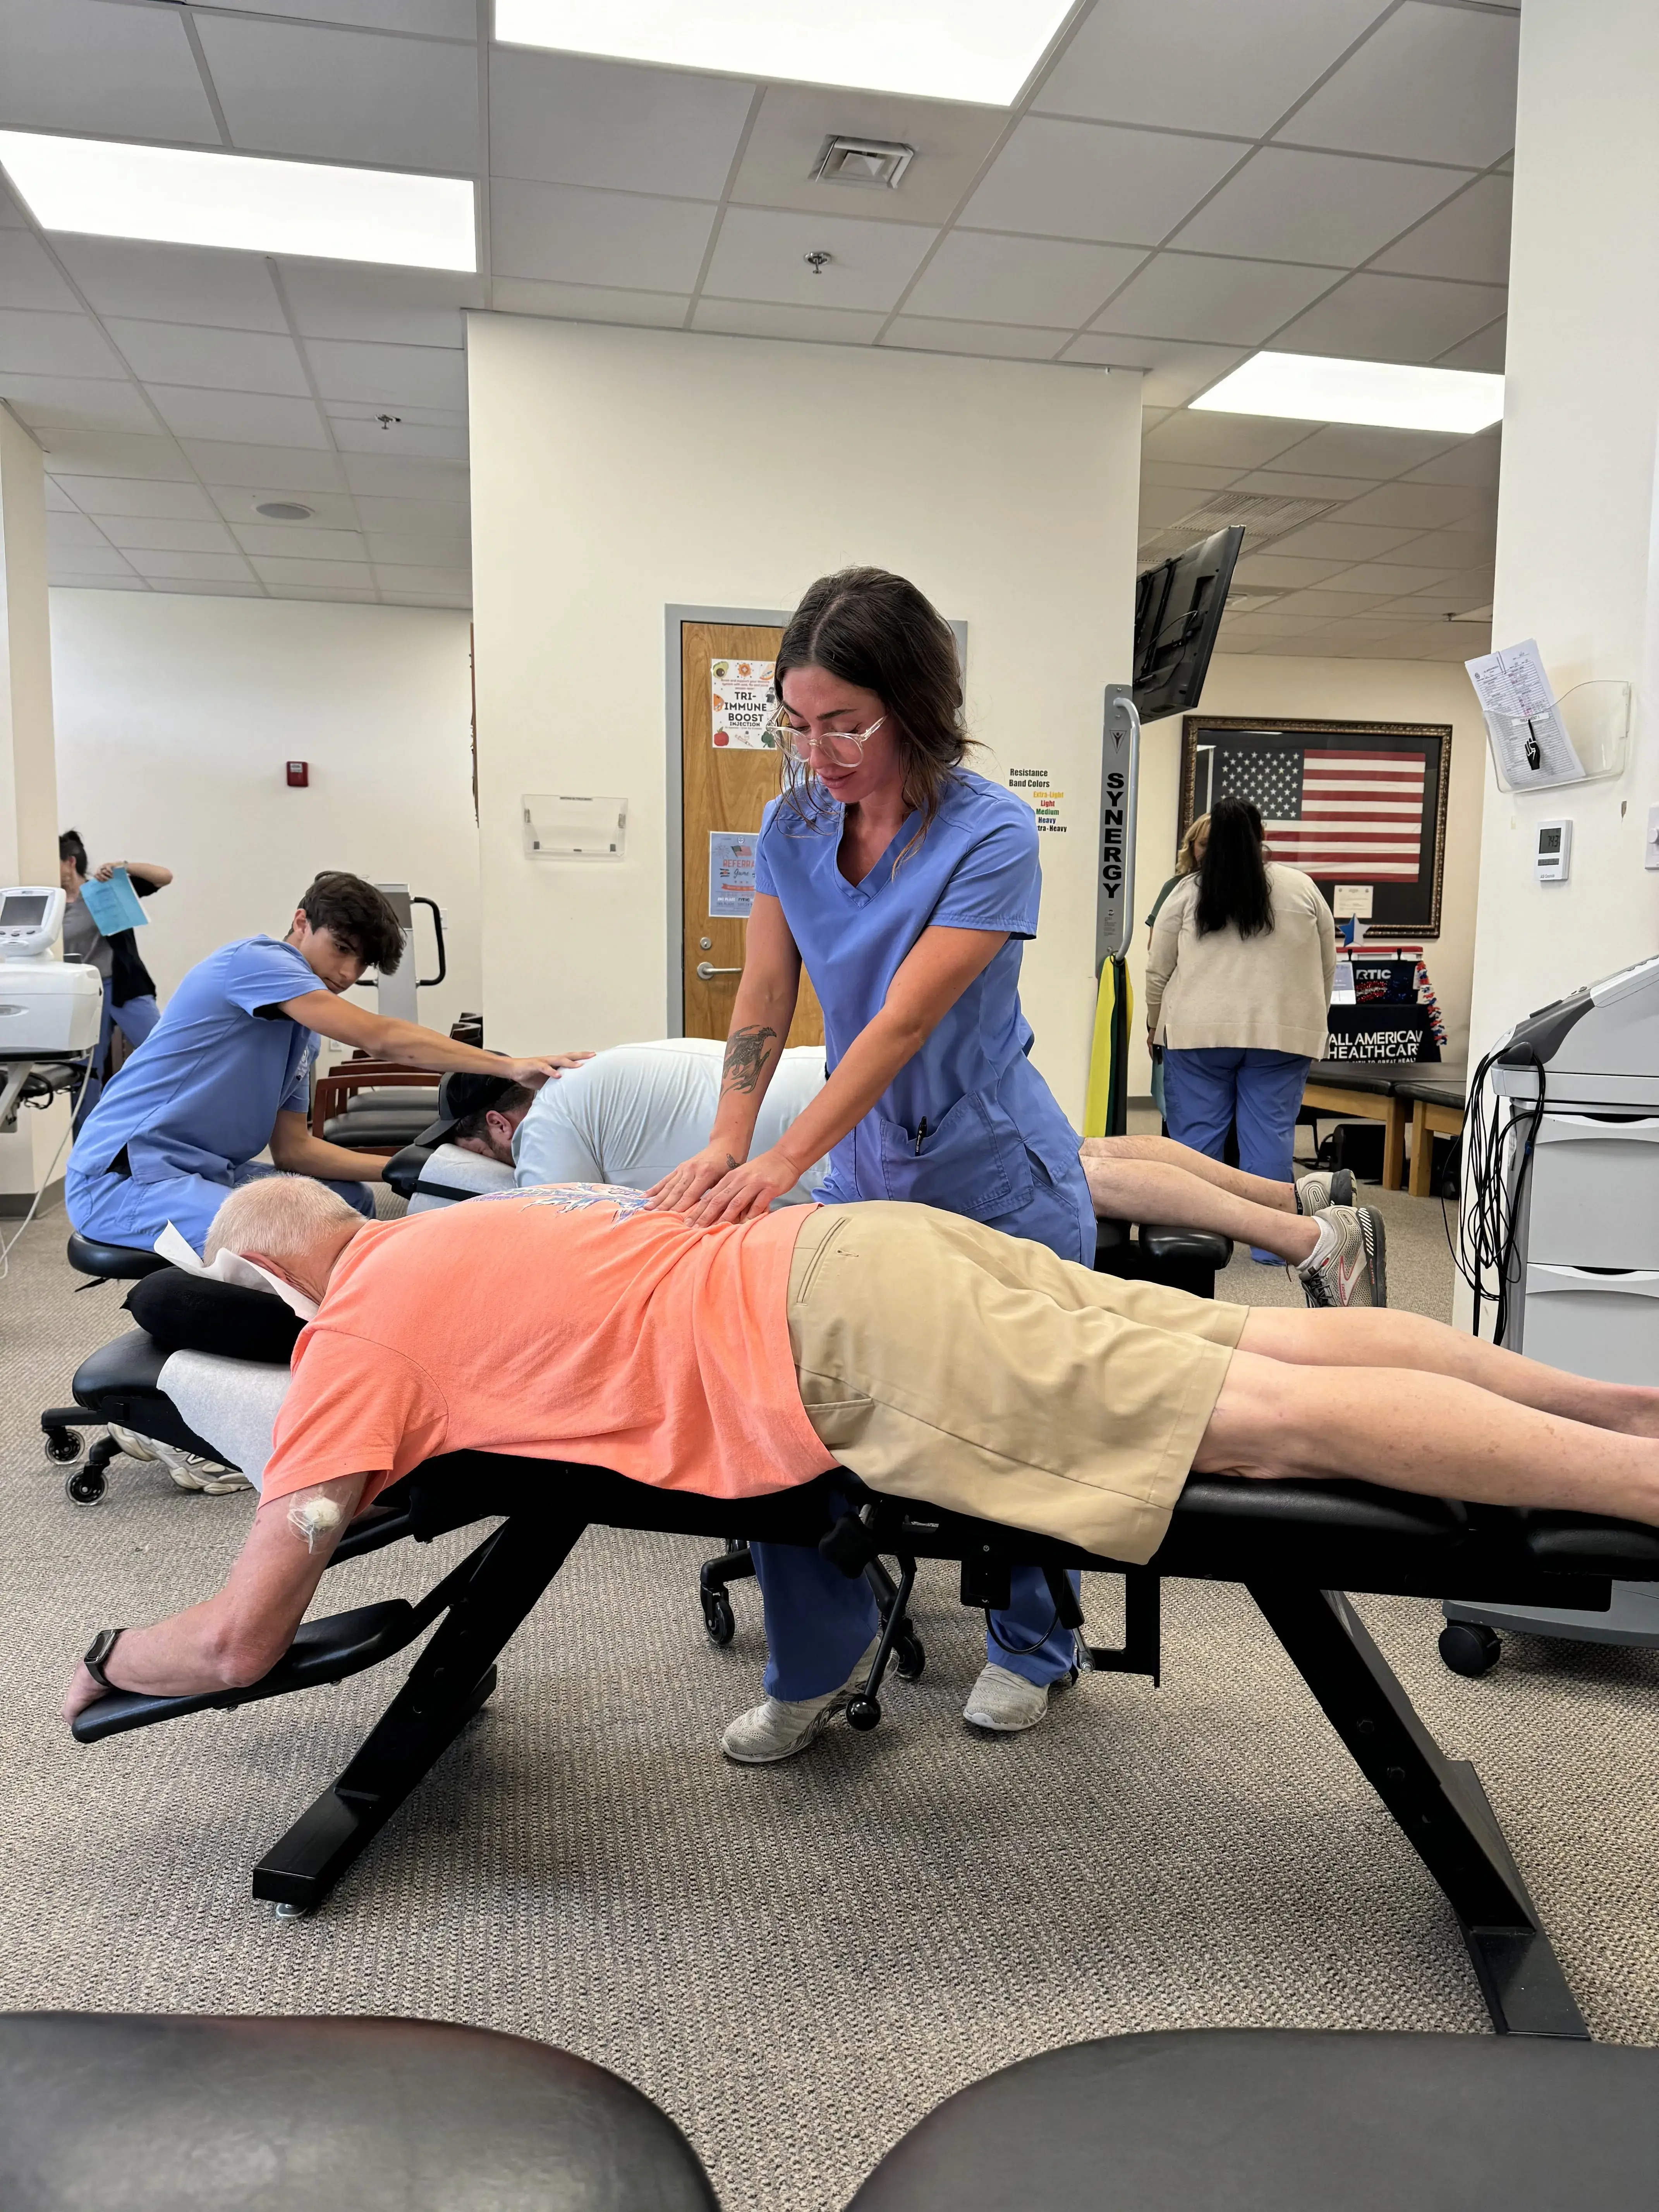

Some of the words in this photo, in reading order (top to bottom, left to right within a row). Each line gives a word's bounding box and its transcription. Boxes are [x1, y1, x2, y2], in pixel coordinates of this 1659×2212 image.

[735, 692, 756, 700] TRI-
[724, 702, 767, 711] IMMUNE
[728, 713, 764, 722] BOOST
[1010, 768, 1048, 776] Resistance
[1028, 780, 1050, 788] Colors
[1102, 772, 1124, 899] SYNERGY
[723, 859, 754, 868] REFERRA
[1356, 969, 1391, 980] RTIC
[1329, 1033, 1353, 1046] ALL
[1328, 1043, 1420, 1059] HEALTHCAR
